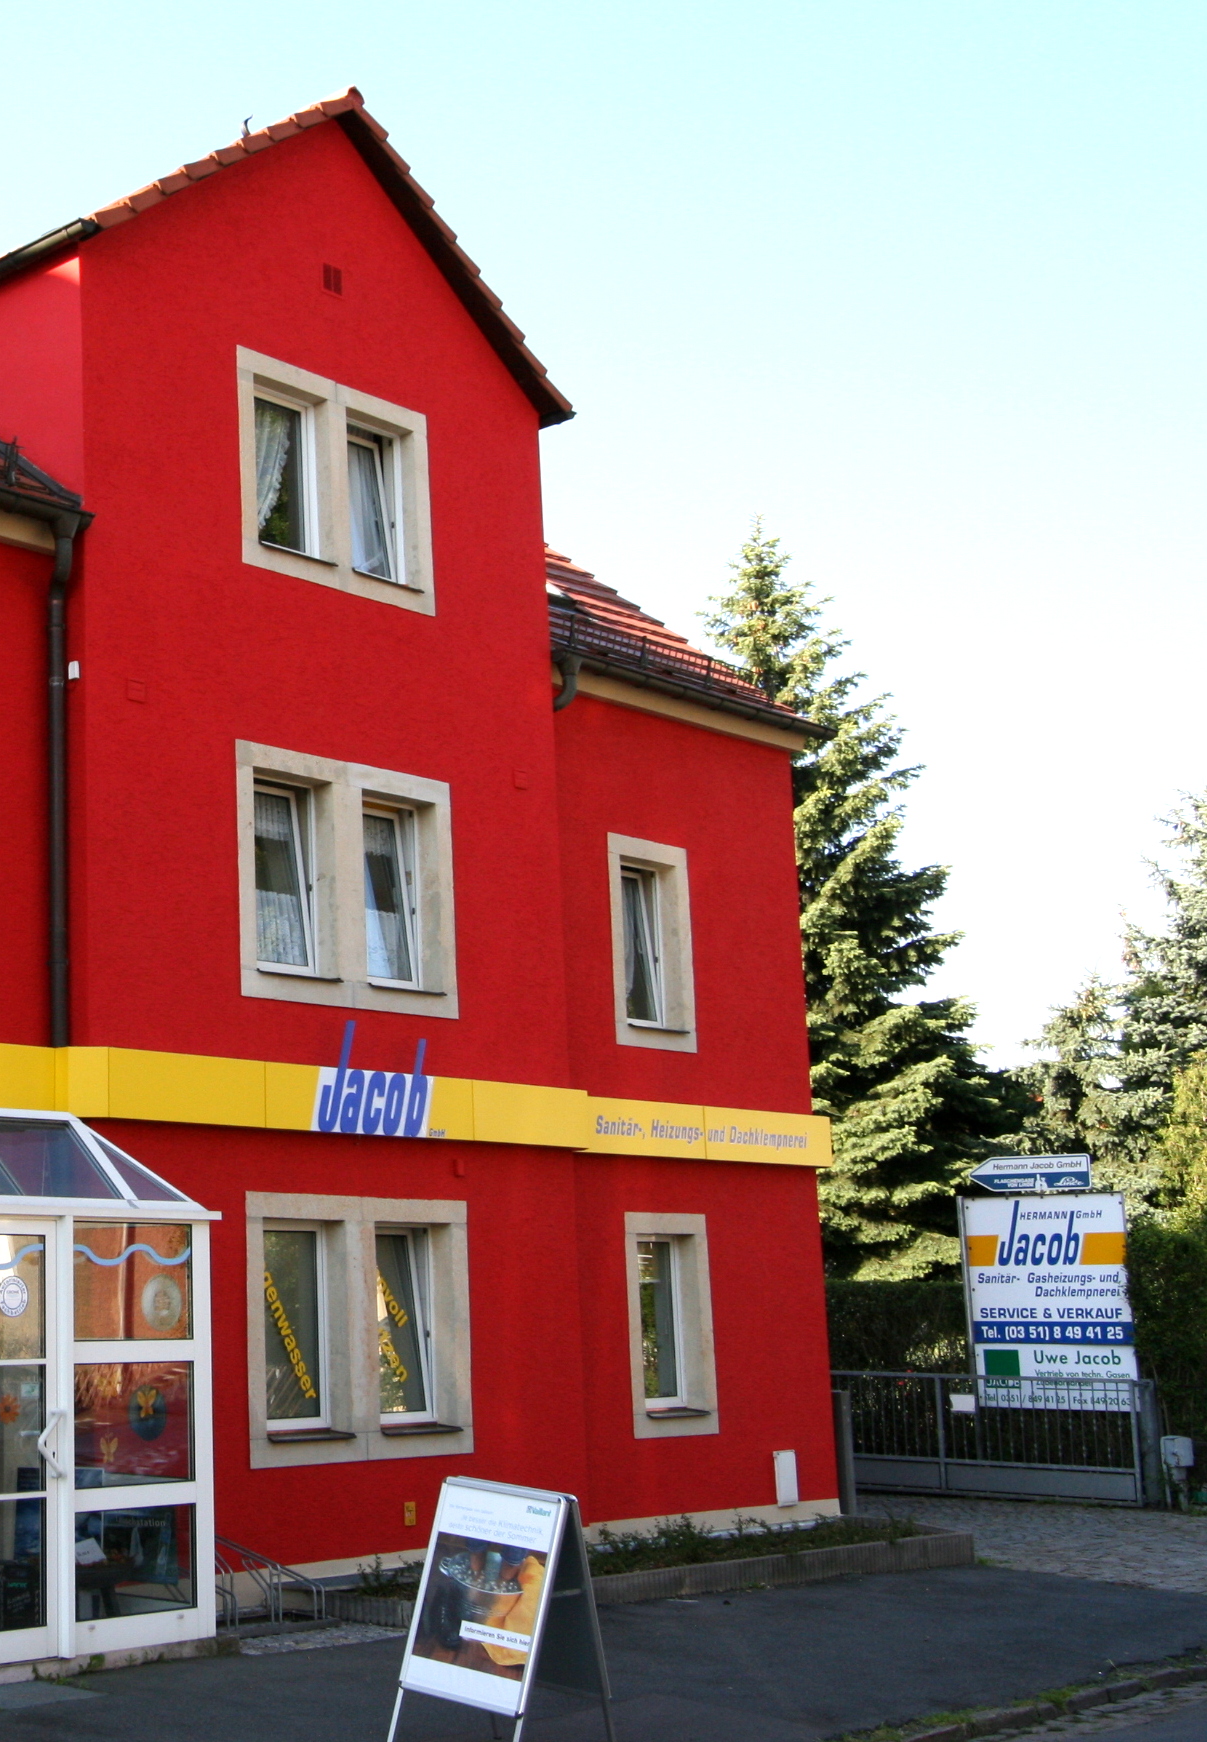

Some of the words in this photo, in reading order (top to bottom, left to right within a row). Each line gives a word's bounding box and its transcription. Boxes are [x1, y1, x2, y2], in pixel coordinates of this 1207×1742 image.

[318, 1020, 428, 1137] Jacob
[708, 1126, 726, 1142] und
[730, 1126, 808, 1150] Dachklempnerei
[1030, 1161, 1054, 1170] Jacob
[1056, 1160, 1082, 1168] GmbH
[1020, 1211, 1068, 1220] HERMANN
[1076, 1210, 1102, 1219] GmbH
[998, 1200, 1080, 1266] Jacob
[978, 1272, 1020, 1284] Sanitär-
[1027, 1272, 1096, 1286] Gasheizungs-
[1035, 1286, 1120, 1299] Dachklempnerei
[980, 1308, 1037, 1319] SERVICE
[1043, 1308, 1052, 1319] &
[1057, 1308, 1123, 1319] VERKAUF
[264, 1269, 318, 1399] genwasser
[981, 1326, 1000, 1338] Tel.
[1005, 1326, 1025, 1340] (03
[1029, 1326, 1049, 1340] 51)
[1053, 1326, 1061, 1338] 8
[1065, 1326, 1082, 1338] 49
[1086, 1326, 1102, 1339] 41
[1107, 1327, 1124, 1339] 25
[1034, 1350, 1068, 1364] Uwe
[1075, 1350, 1121, 1365] Jacob
[1034, 1369, 1064, 1377] Vertrieb
[1082, 1370, 1104, 1378] techn.
[1106, 1370, 1130, 1378] Gasen
